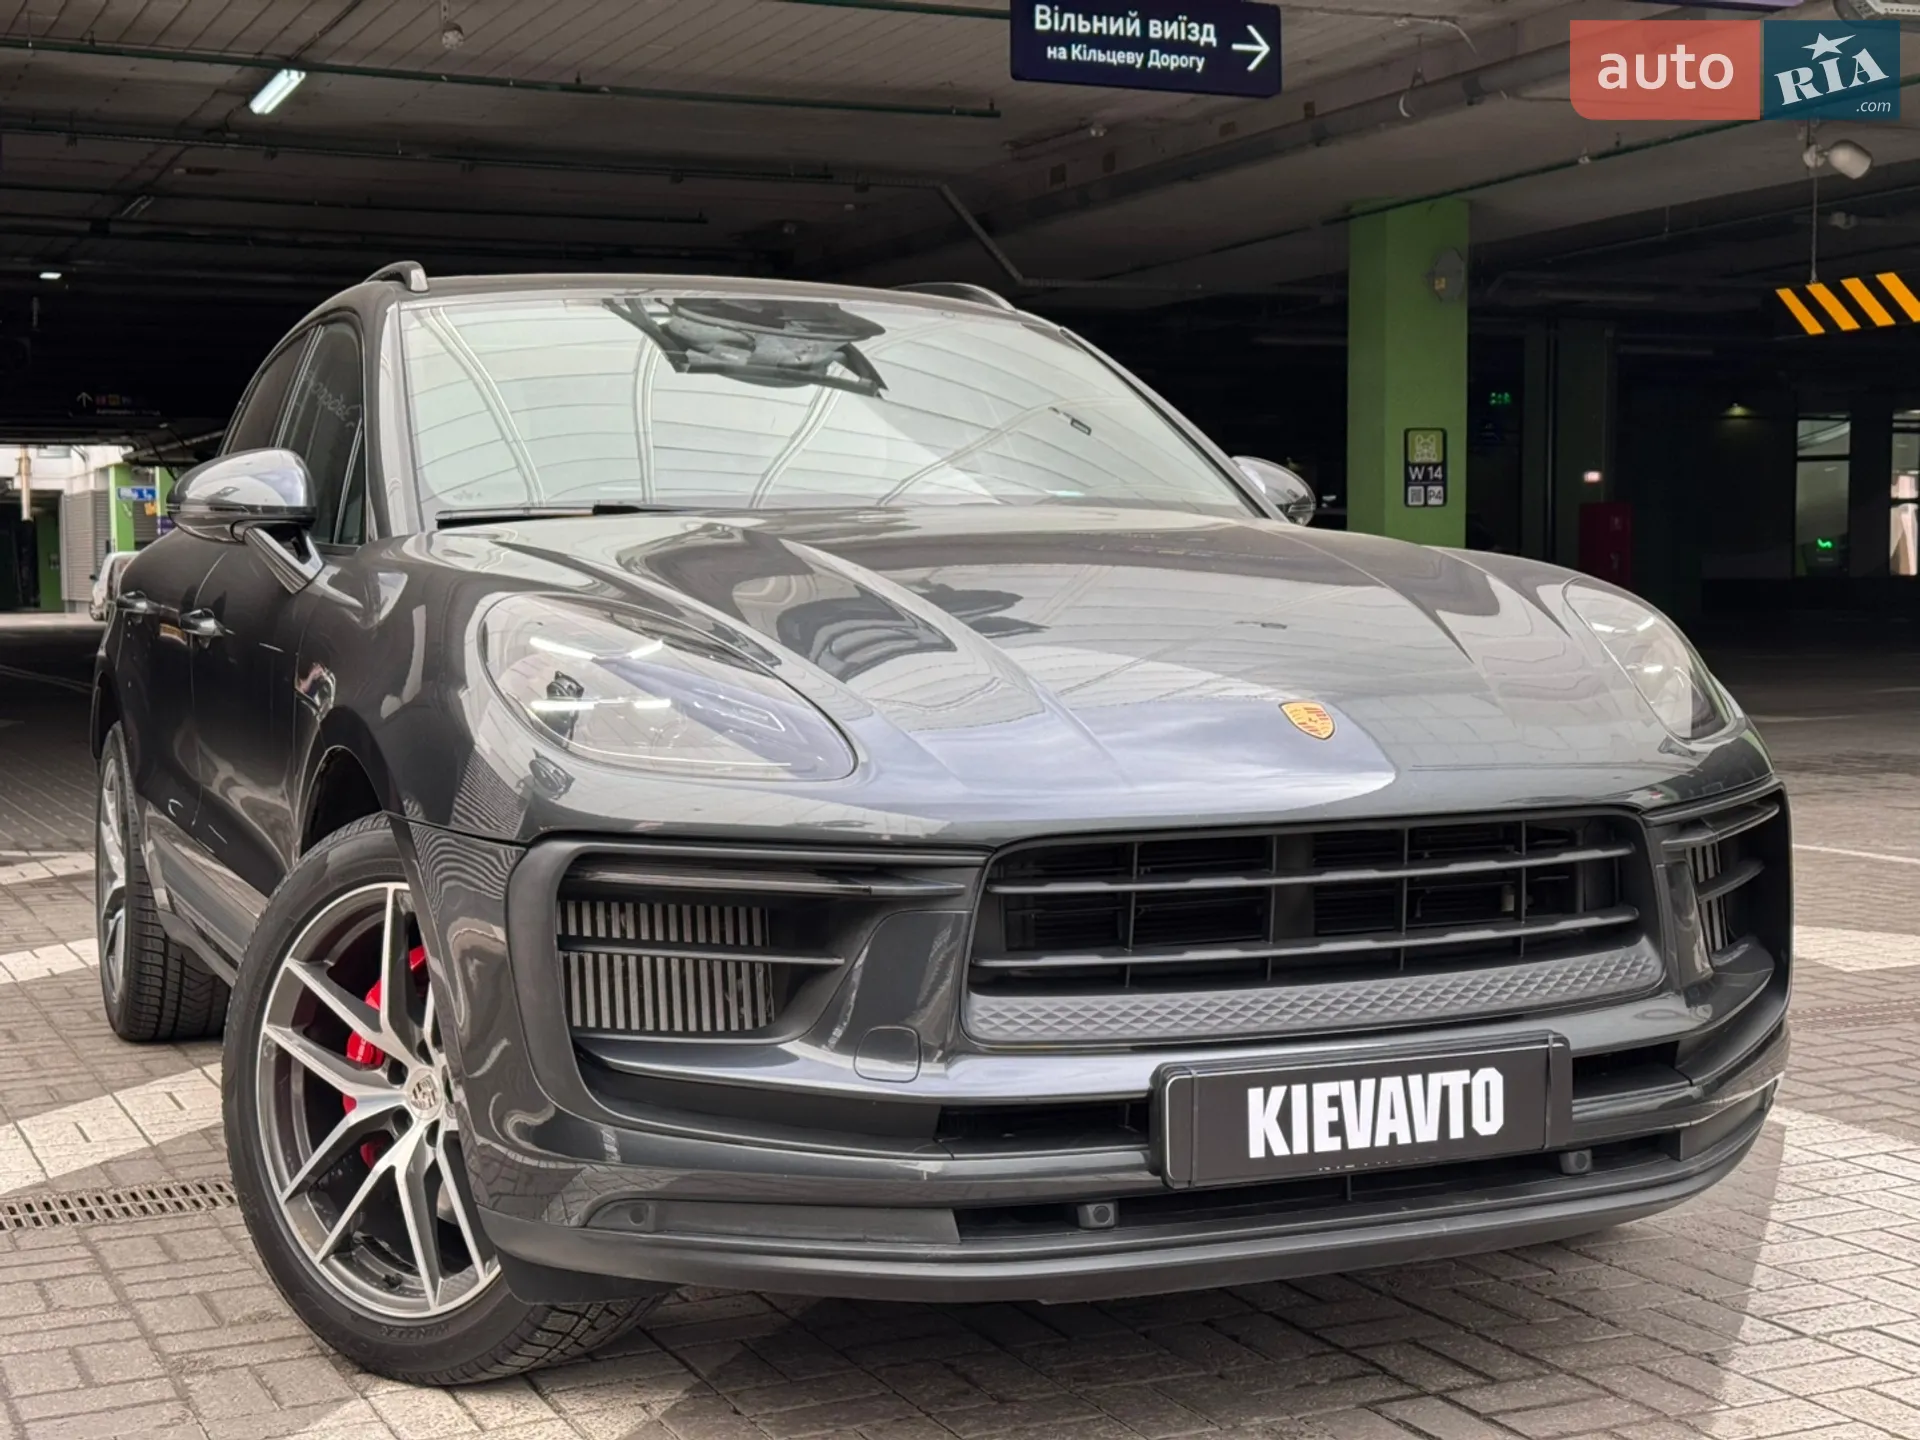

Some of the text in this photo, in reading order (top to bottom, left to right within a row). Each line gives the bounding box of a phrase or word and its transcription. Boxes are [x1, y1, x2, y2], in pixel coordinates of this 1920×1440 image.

[1034, 4, 1217, 47] Вільний виїзд
[1047, 44, 1205, 72] на Кільцеву Дорогу
[1408, 466, 1442, 480] W 14
[1247, 1067, 1504, 1159] KIEVAVTO
